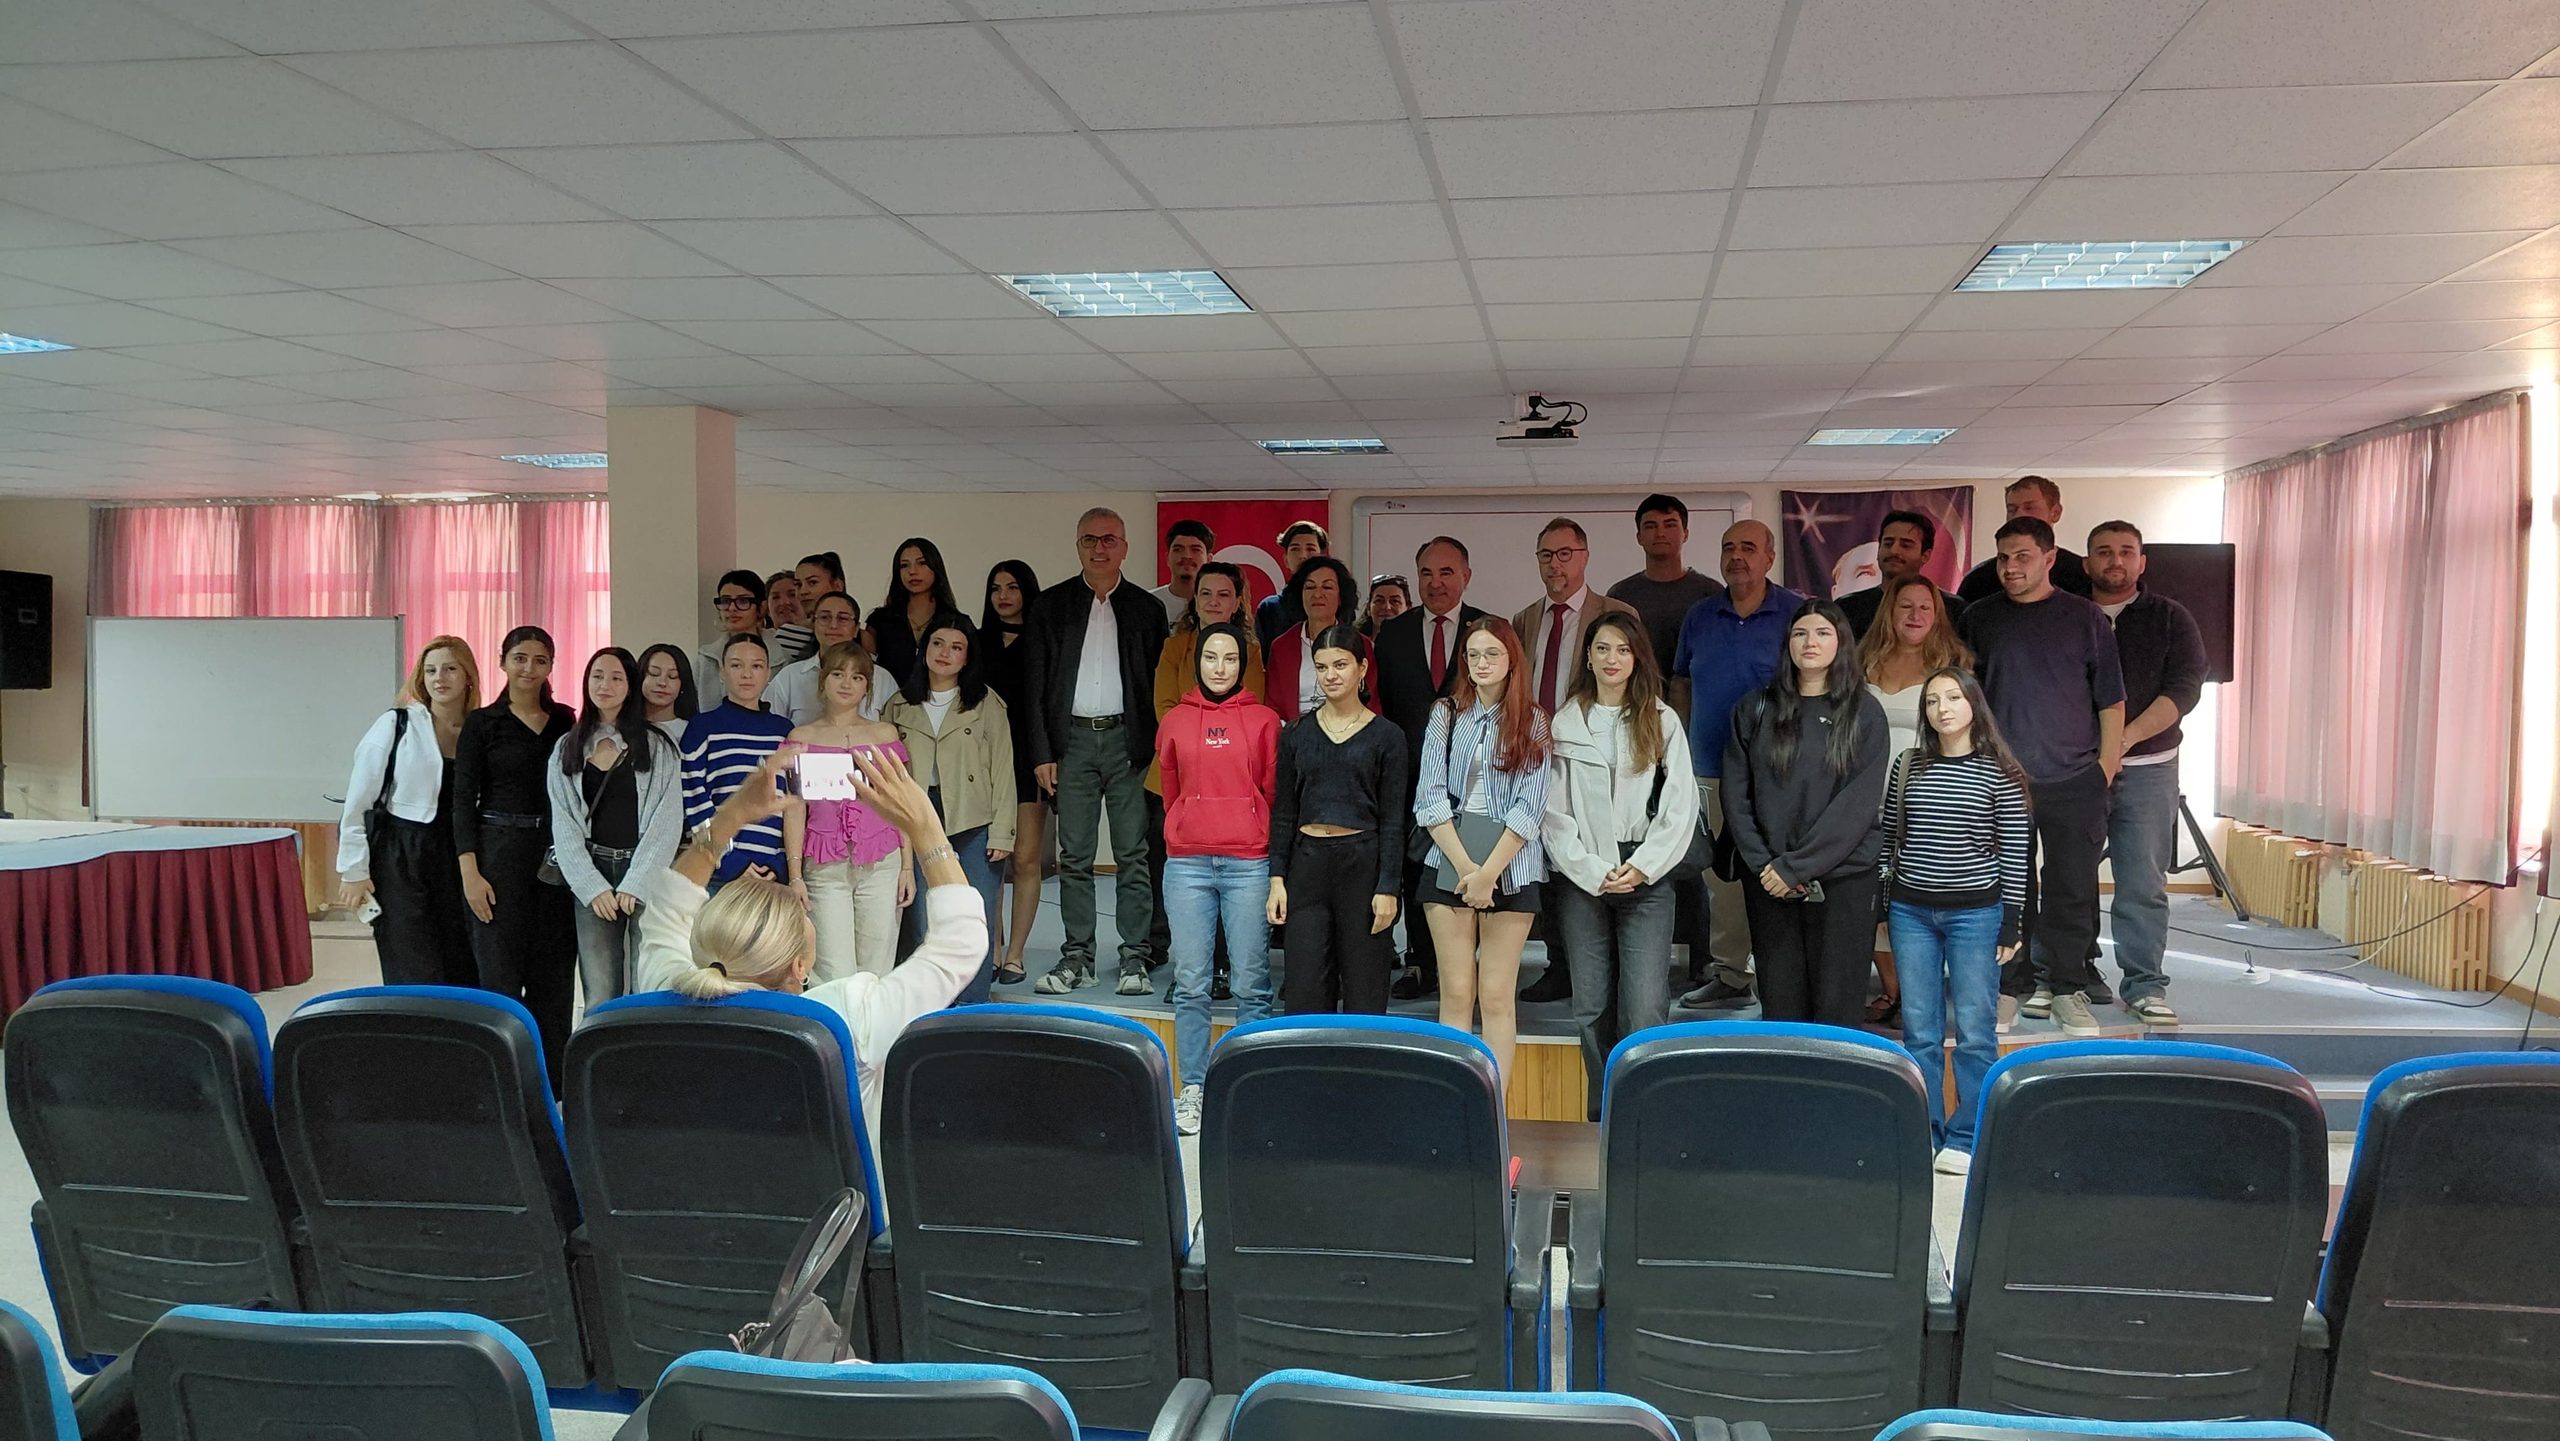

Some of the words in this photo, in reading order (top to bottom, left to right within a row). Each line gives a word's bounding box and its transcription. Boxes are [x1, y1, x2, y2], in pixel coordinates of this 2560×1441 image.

[1207, 727, 1227, 737] NY
[1205, 737, 1217, 745] New
[1217, 737, 1230, 745] York
